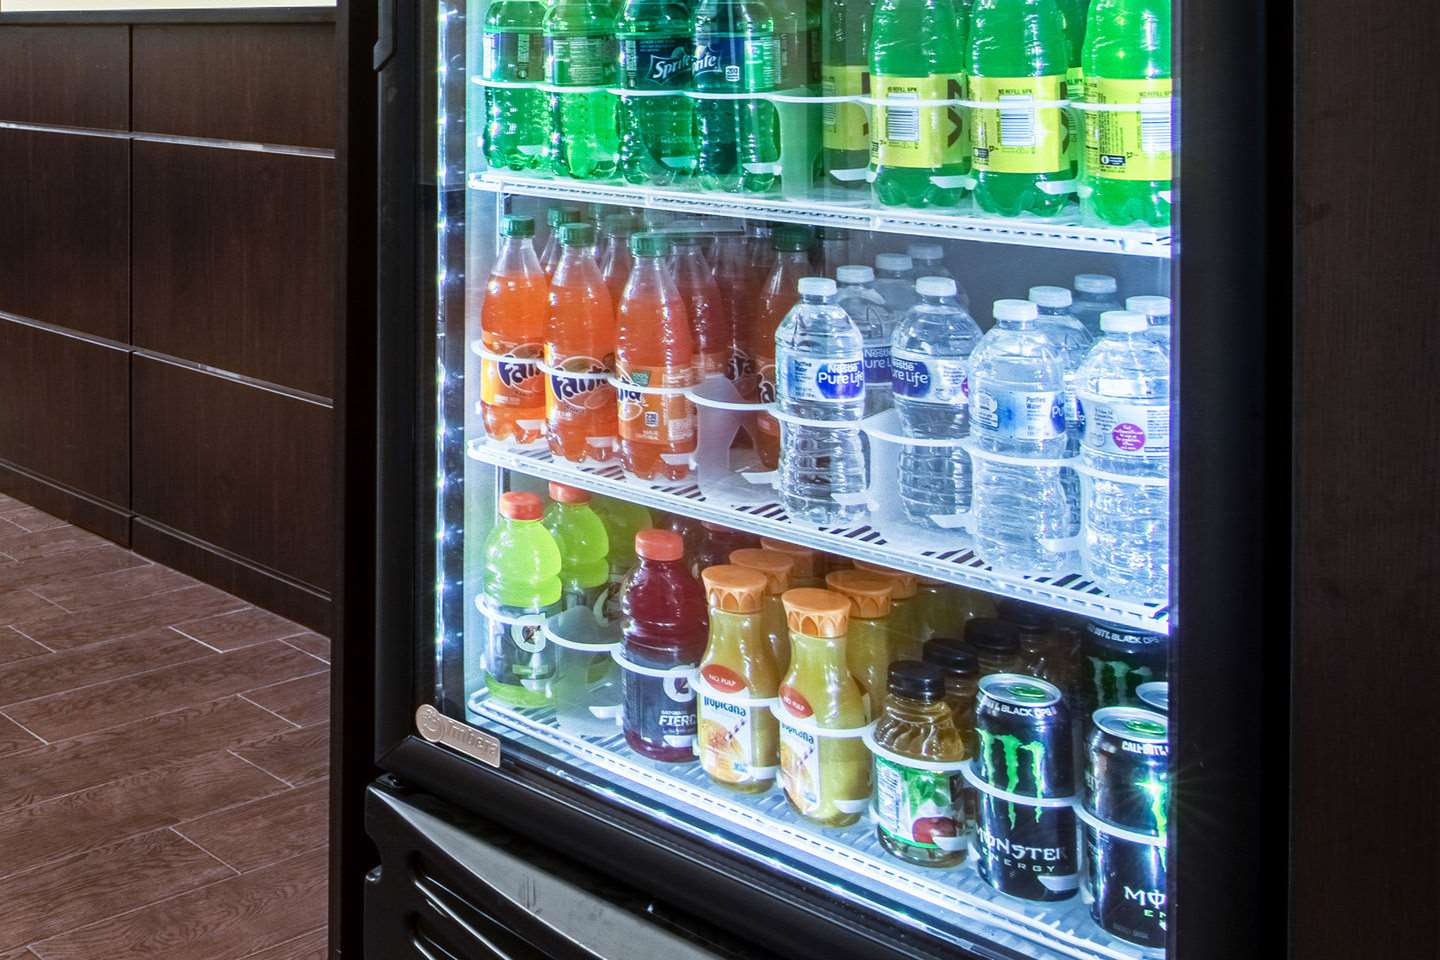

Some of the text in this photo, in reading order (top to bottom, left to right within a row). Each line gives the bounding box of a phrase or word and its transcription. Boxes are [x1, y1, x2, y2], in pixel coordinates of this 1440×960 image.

[818, 371, 850, 385] Pure
[905, 370, 929, 388] Life
[709, 673, 720, 681] NO
[1001, 704, 1033, 717] BLACK
[977, 827, 1068, 861] MONSTER
[982, 846, 1055, 873] ENERGY
